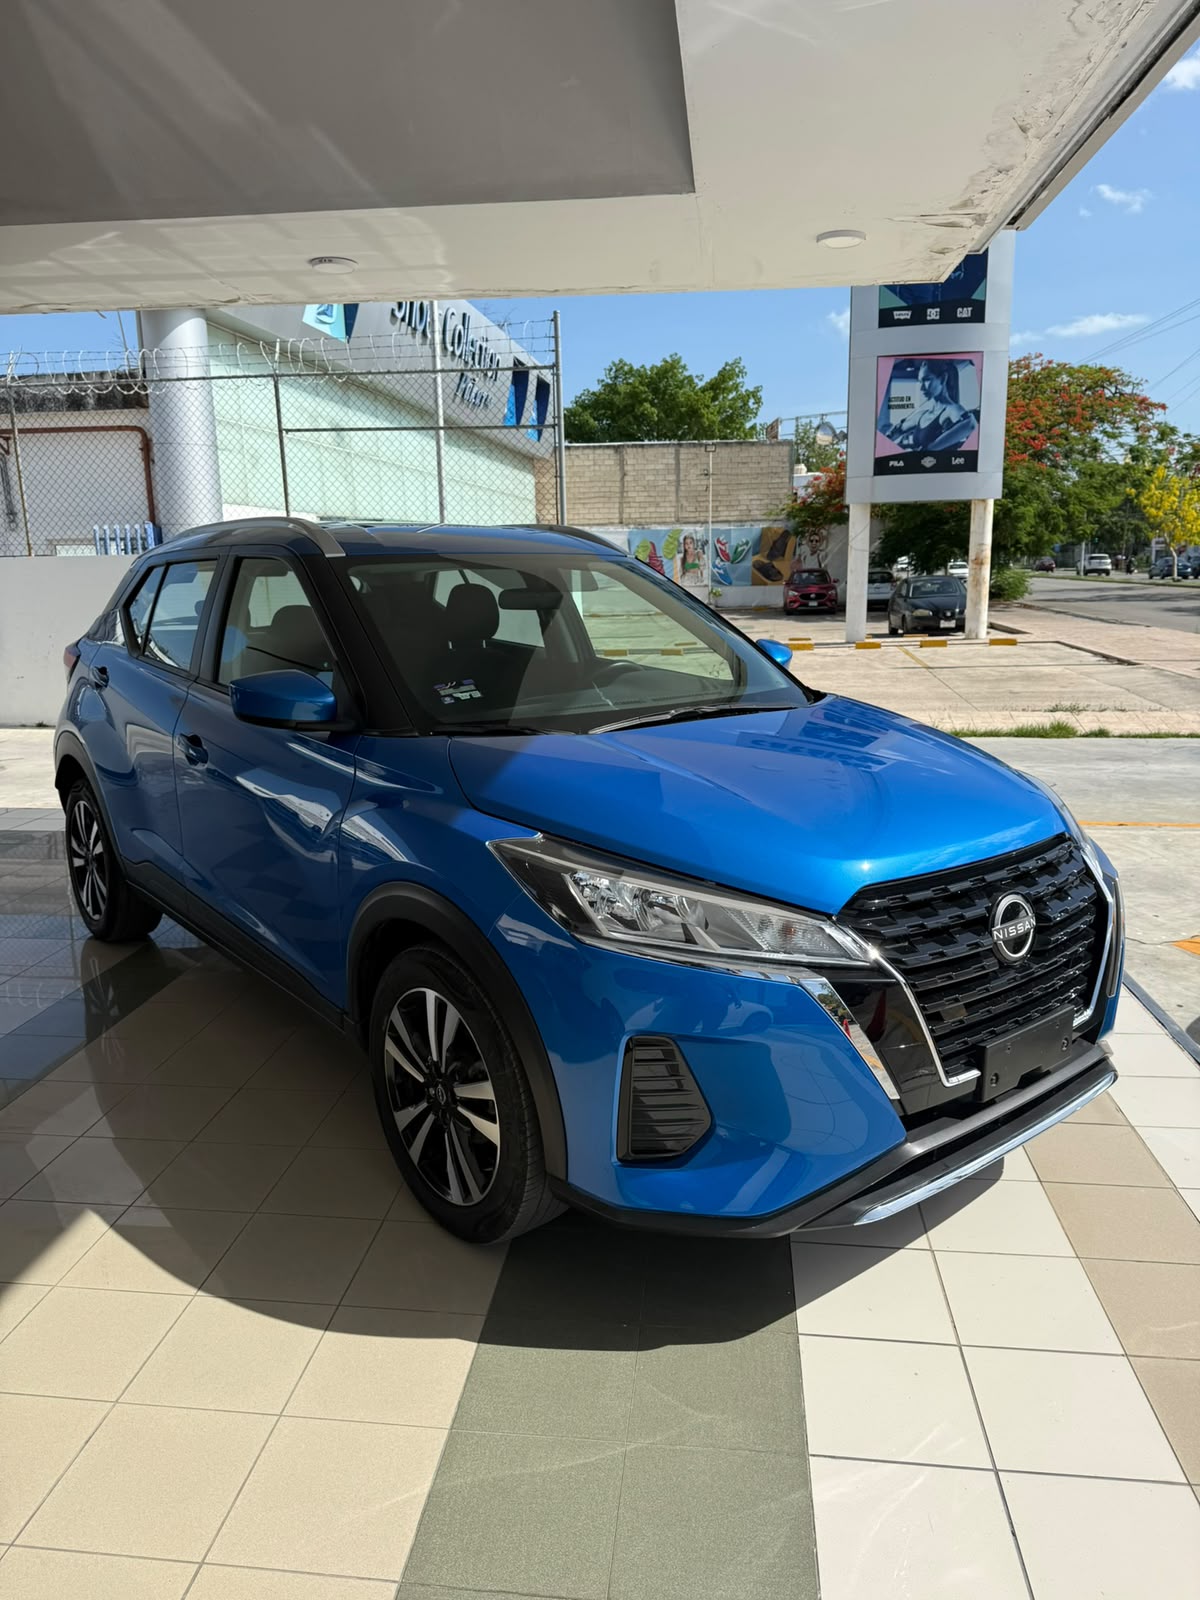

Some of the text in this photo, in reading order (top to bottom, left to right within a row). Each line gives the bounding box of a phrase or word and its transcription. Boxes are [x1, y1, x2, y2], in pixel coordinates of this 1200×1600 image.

[957, 307, 973, 318] CAT
[951, 456, 965, 465] Lee
[993, 917, 1036, 941] NISSAN
